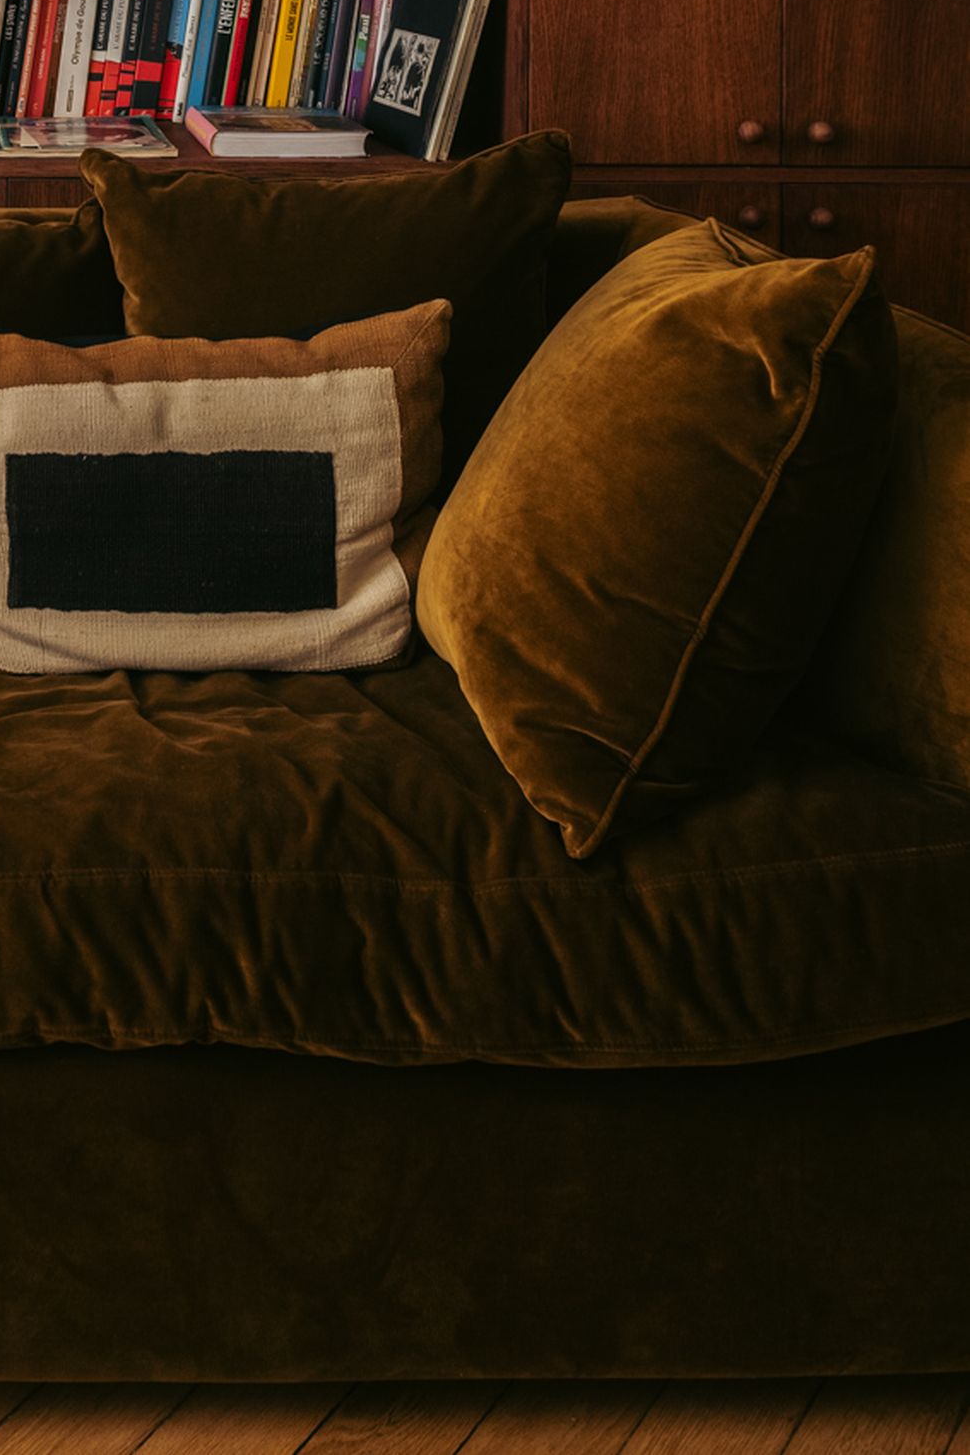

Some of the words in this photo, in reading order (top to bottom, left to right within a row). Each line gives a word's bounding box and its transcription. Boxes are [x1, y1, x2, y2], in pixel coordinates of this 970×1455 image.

[74, 16, 84, 29] de
[99, 9, 107, 20] DU
[356, 12, 372, 40] Paul
[69, 30, 84, 65] Olympe
